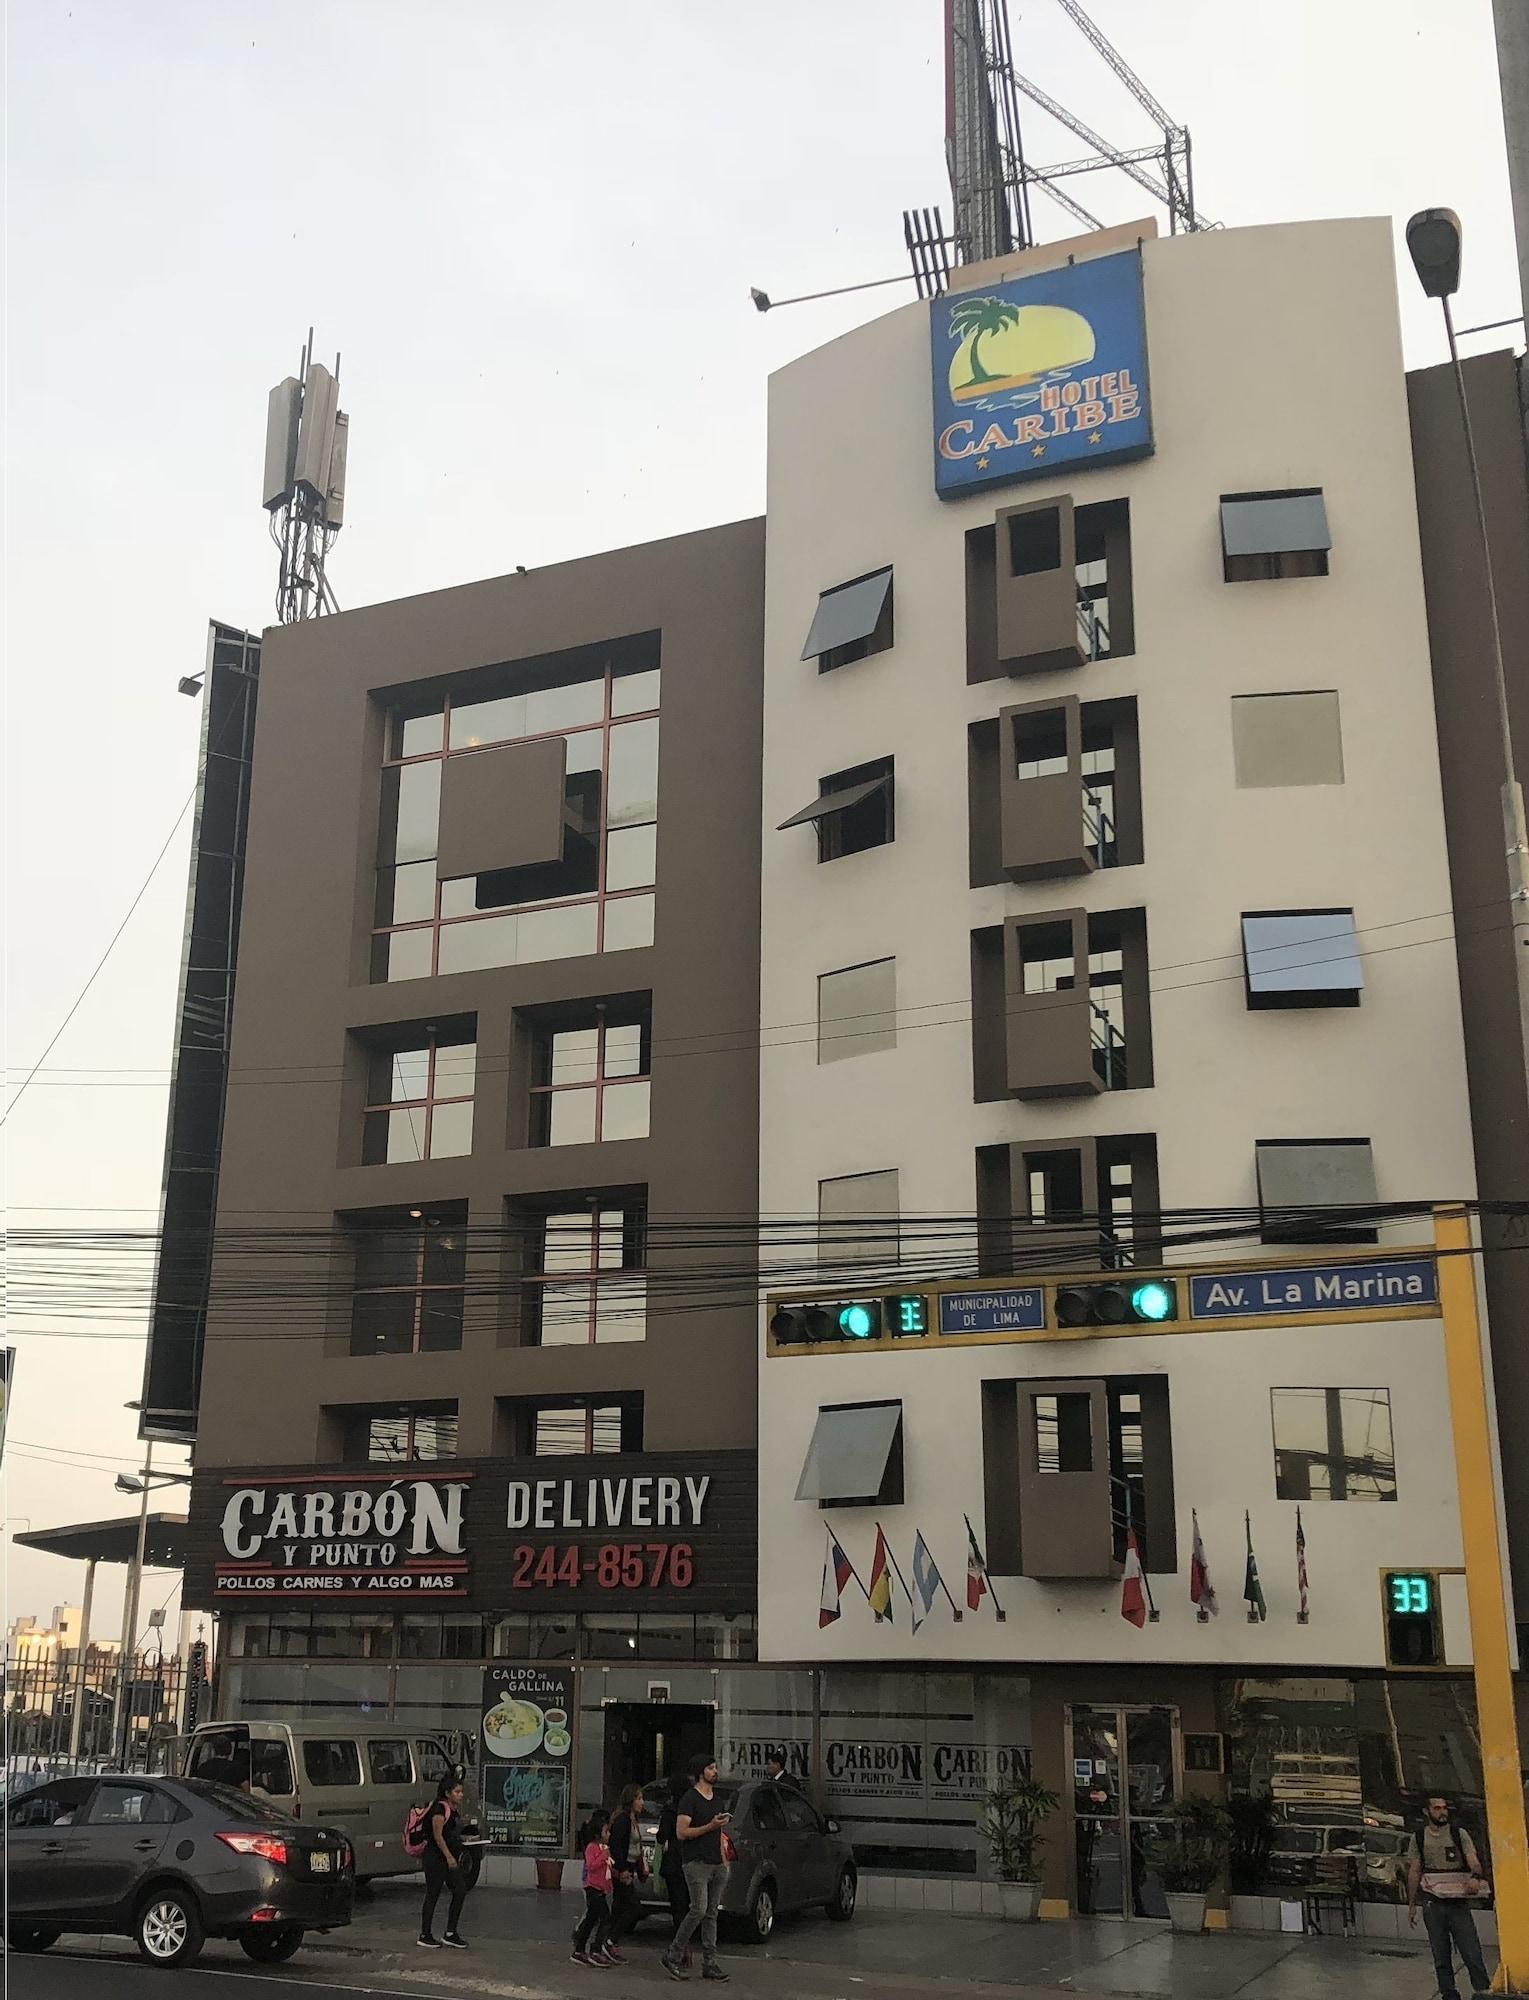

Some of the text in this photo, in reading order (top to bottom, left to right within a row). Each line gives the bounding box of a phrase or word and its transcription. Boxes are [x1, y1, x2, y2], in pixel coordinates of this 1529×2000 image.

[1040, 369, 1138, 412] HOTEL
[939, 391, 1142, 460] CARIBE
[949, 1294, 1033, 1312] MUNICIPALIDAD
[1205, 1271, 1424, 1309] Av. La Marina
[963, 1311, 1020, 1327] DE LIMA
[506, 1475, 710, 1529] DELIVERY
[219, 1479, 471, 1560] CARBÓN
[283, 1542, 397, 1567] Y PUNTO
[512, 1543, 693, 1589] 244-8576
[217, 1575, 455, 1590] POLLOS CARNES Y ALGO MAS
[1392, 1577, 1429, 1613] 33
[492, 1669, 537, 1680] CALDO
[508, 1681, 565, 1692] GALLINA
[825, 1742, 922, 1781] CARBON
[850, 1772, 895, 1784] Y PUNTO
[958, 1776, 964, 1788] Y
